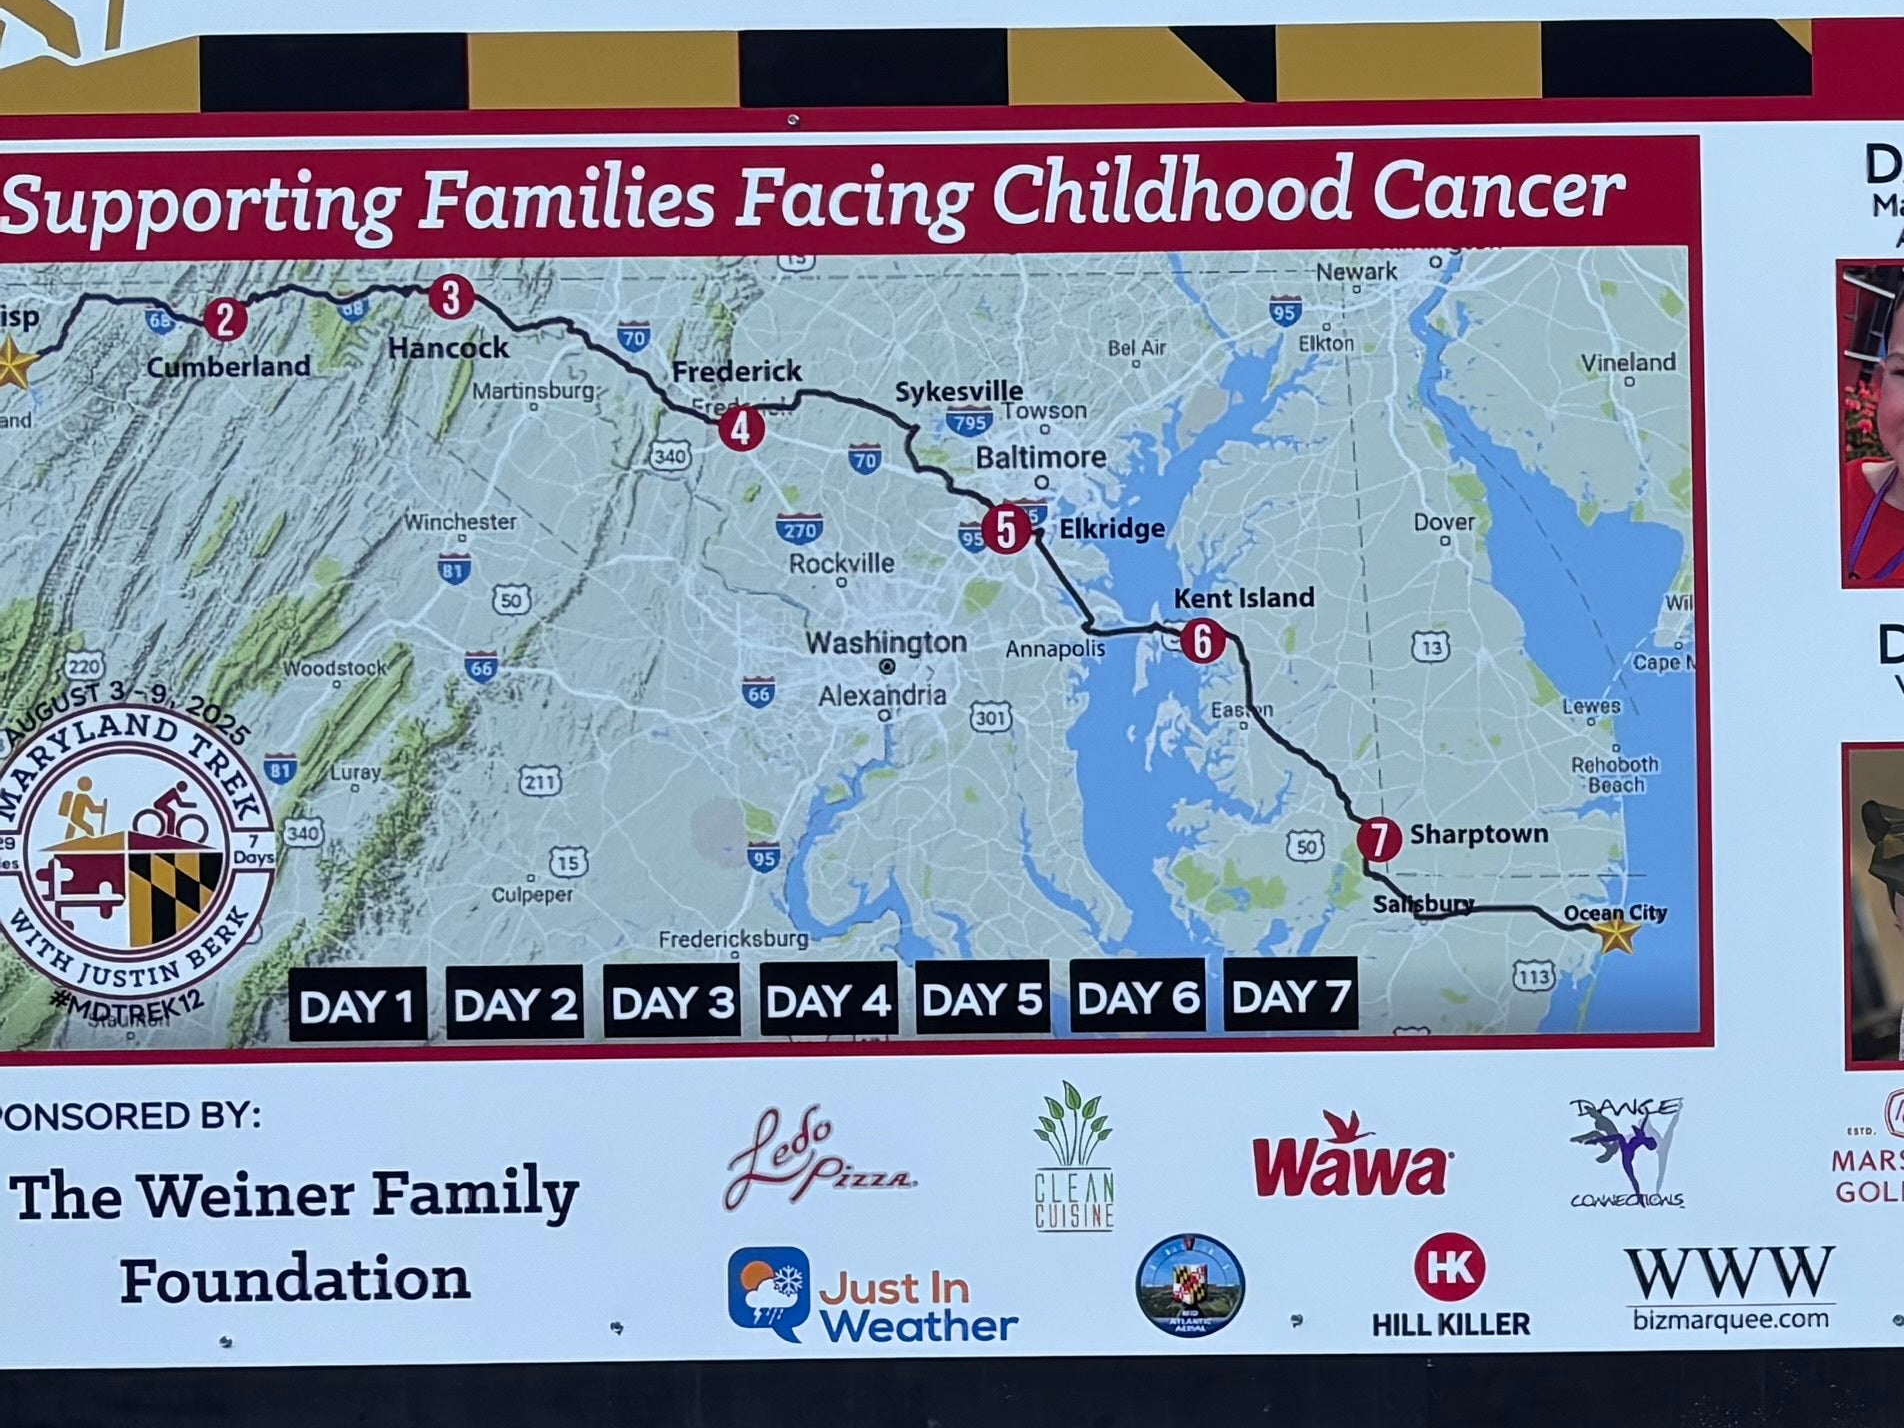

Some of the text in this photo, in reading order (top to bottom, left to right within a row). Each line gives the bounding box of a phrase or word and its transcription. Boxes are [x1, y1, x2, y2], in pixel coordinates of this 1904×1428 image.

[0, 151, 1627, 252] Supporting Families Facing Childhood Cancer
[1317, 261, 1398, 280] Newark
[389, 334, 510, 362] Hancock
[1107, 337, 1167, 357] Bel Air
[1299, 333, 1355, 354] Elkton
[147, 354, 310, 378] Cumberland
[673, 358, 803, 382] Frederick
[1581, 351, 1677, 373] Vineland
[472, 379, 596, 406] Martinsburg
[895, 379, 1024, 407] Sykesville
[1003, 400, 1088, 422] Towson
[655, 450, 685, 463] 340
[975, 443, 1107, 471] Baltimore
[404, 510, 517, 533] Winchester
[1060, 516, 1166, 545] Elkridge
[1415, 512, 1476, 532] Dover
[790, 551, 895, 576] Rockville
[1173, 586, 1315, 610] Kent Island
[806, 627, 968, 660] Washington
[1005, 637, 1107, 663] Annapolis
[283, 658, 388, 680] Woodstock
[818, 681, 948, 710] Alexandria
[1563, 699, 1621, 714] Lewes
[6, 680, 252, 748] AUGUST 3 9, 2025
[0, 714, 260, 822] MARYLAND TREK
[1410, 821, 1550, 850] Sharptown
[491, 884, 574, 907] Culpeper
[1372, 894, 1474, 918] Salisbury
[1564, 901, 1668, 926] Ocean City
[10, 905, 250, 988] WITH JUSTIN BERK
[658, 928, 809, 955] Fredericksburg
[50, 989, 205, 1023] #MDTREK12
[300, 988, 415, 1025] DAY 1
[0, 1100, 261, 1131] ONSORED BY:
[1569, 1097, 1684, 1116] DANCE
[1847, 1126, 1876, 1136] ESTD.
[724, 1103, 831, 1211] Ledo
[1252, 1134, 1449, 1197] Wawa
[9, 1162, 581, 1228] The Weiner Family
[1034, 1172, 1114, 1204] CLEAN
[1571, 1193, 1685, 1208] CONNECTIONS
[1035, 1203, 1114, 1229] CUISINE
[119, 1249, 472, 1304] Foundation
[1427, 1251, 1476, 1284] HK
[1623, 1245, 1837, 1300] WWW
[818, 1269, 970, 1306] Just In
[818, 1307, 1020, 1343] Weather
[1372, 1312, 1531, 1337] HILL KILLER
[1633, 1308, 1829, 1335] bizmarquee.com
